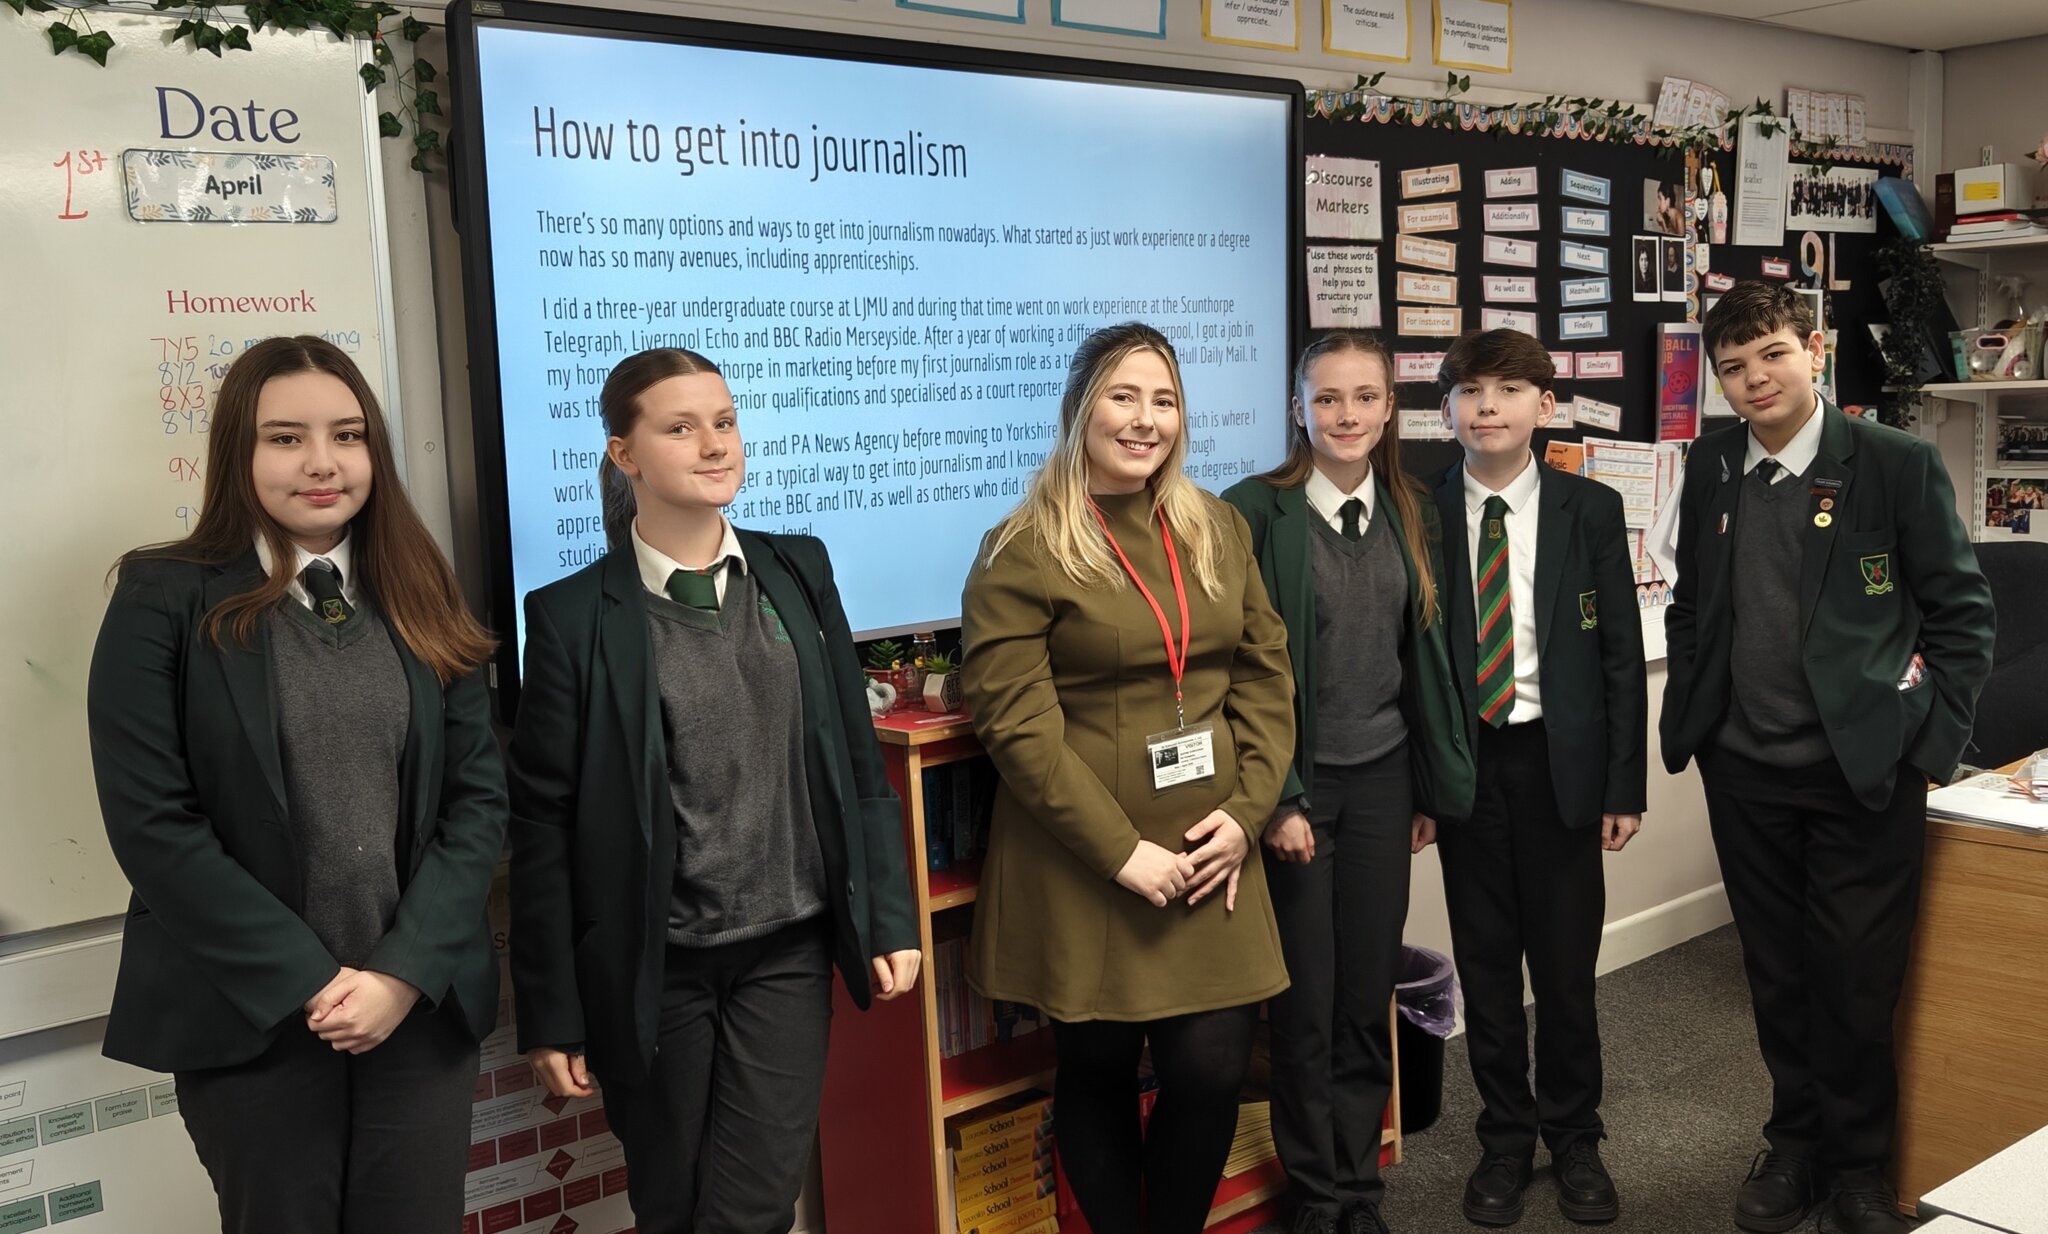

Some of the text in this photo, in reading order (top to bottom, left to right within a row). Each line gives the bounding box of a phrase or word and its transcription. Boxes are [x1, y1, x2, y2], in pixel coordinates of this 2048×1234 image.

[1224, 1, 1278, 17] infer understand
[1342, 3, 1395, 20] The audience would
[155, 86, 301, 144] Date
[534, 106, 967, 182] How to get into journalism
[52, 150, 108, 220] 1st
[1309, 169, 1373, 188] Discourse
[1411, 174, 1450, 187] Illustrating
[1499, 176, 1522, 187] Adding
[205, 174, 262, 200] April
[1569, 180, 1602, 195] Sequencing
[1315, 198, 1370, 215] Markers
[1406, 211, 1450, 225] For example
[1491, 210, 1530, 223] Additionally
[1576, 216, 1595, 227] Firstly
[536, 210, 1250, 252] There's so many options and ways to get into journalism nowadays. What started as just work experience or a degree
[1310, 250, 1374, 261] Use these words
[1503, 246, 1517, 255] And
[1576, 251, 1591, 261] Next
[540, 245, 919, 275] now has so many avenues, including apprenticeships.
[1799, 231, 1852, 291] 9L
[1312, 263, 1373, 278] and phrases to
[1321, 277, 1366, 290] help you to
[1413, 282, 1441, 293] Such as
[1493, 283, 1525, 294] As well as
[1568, 284, 1601, 296] Meanwhile
[167, 289, 317, 313] Homework
[1315, 291, 1373, 304] structure your
[543, 295, 1234, 324] I did a three-year undergraduate course at LJMU and during that time went on work experience at the Scunthorpe
[1331, 304, 1358, 317] writing
[1405, 317, 1450, 327] For instance
[1501, 317, 1516, 327] Also
[1573, 319, 1594, 331] Finally
[544, 324, 1064, 358] Telegraph, Liverpool Echo and BBC Radio Merseyside. After a year of working a
[150, 336, 199, 362] 7Y5
[768, 352, 1052, 381] in marketing before my first journalism role as
[1408, 360, 1435, 371] As with
[1586, 359, 1612, 371] Similarly
[158, 361, 202, 386] 8Y2
[159, 384, 206, 411] 8X3
[1407, 417, 1444, 430] Conversely
[3, 1090, 21, 1100] point
[104, 1104, 122, 1113] Form
[50, 1124, 86, 1138] completed
[56, 1120, 78, 1130] expert
[989, 1116, 1016, 1135] School
[983, 1138, 1009, 1157] School
[981, 1157, 1008, 1177] School
[983, 1177, 1009, 1197] School
[58, 1189, 92, 1203] Additional
[58, 1196, 93, 1210] homework
[58, 1202, 95, 1217] completed
[986, 1198, 1012, 1217] School
